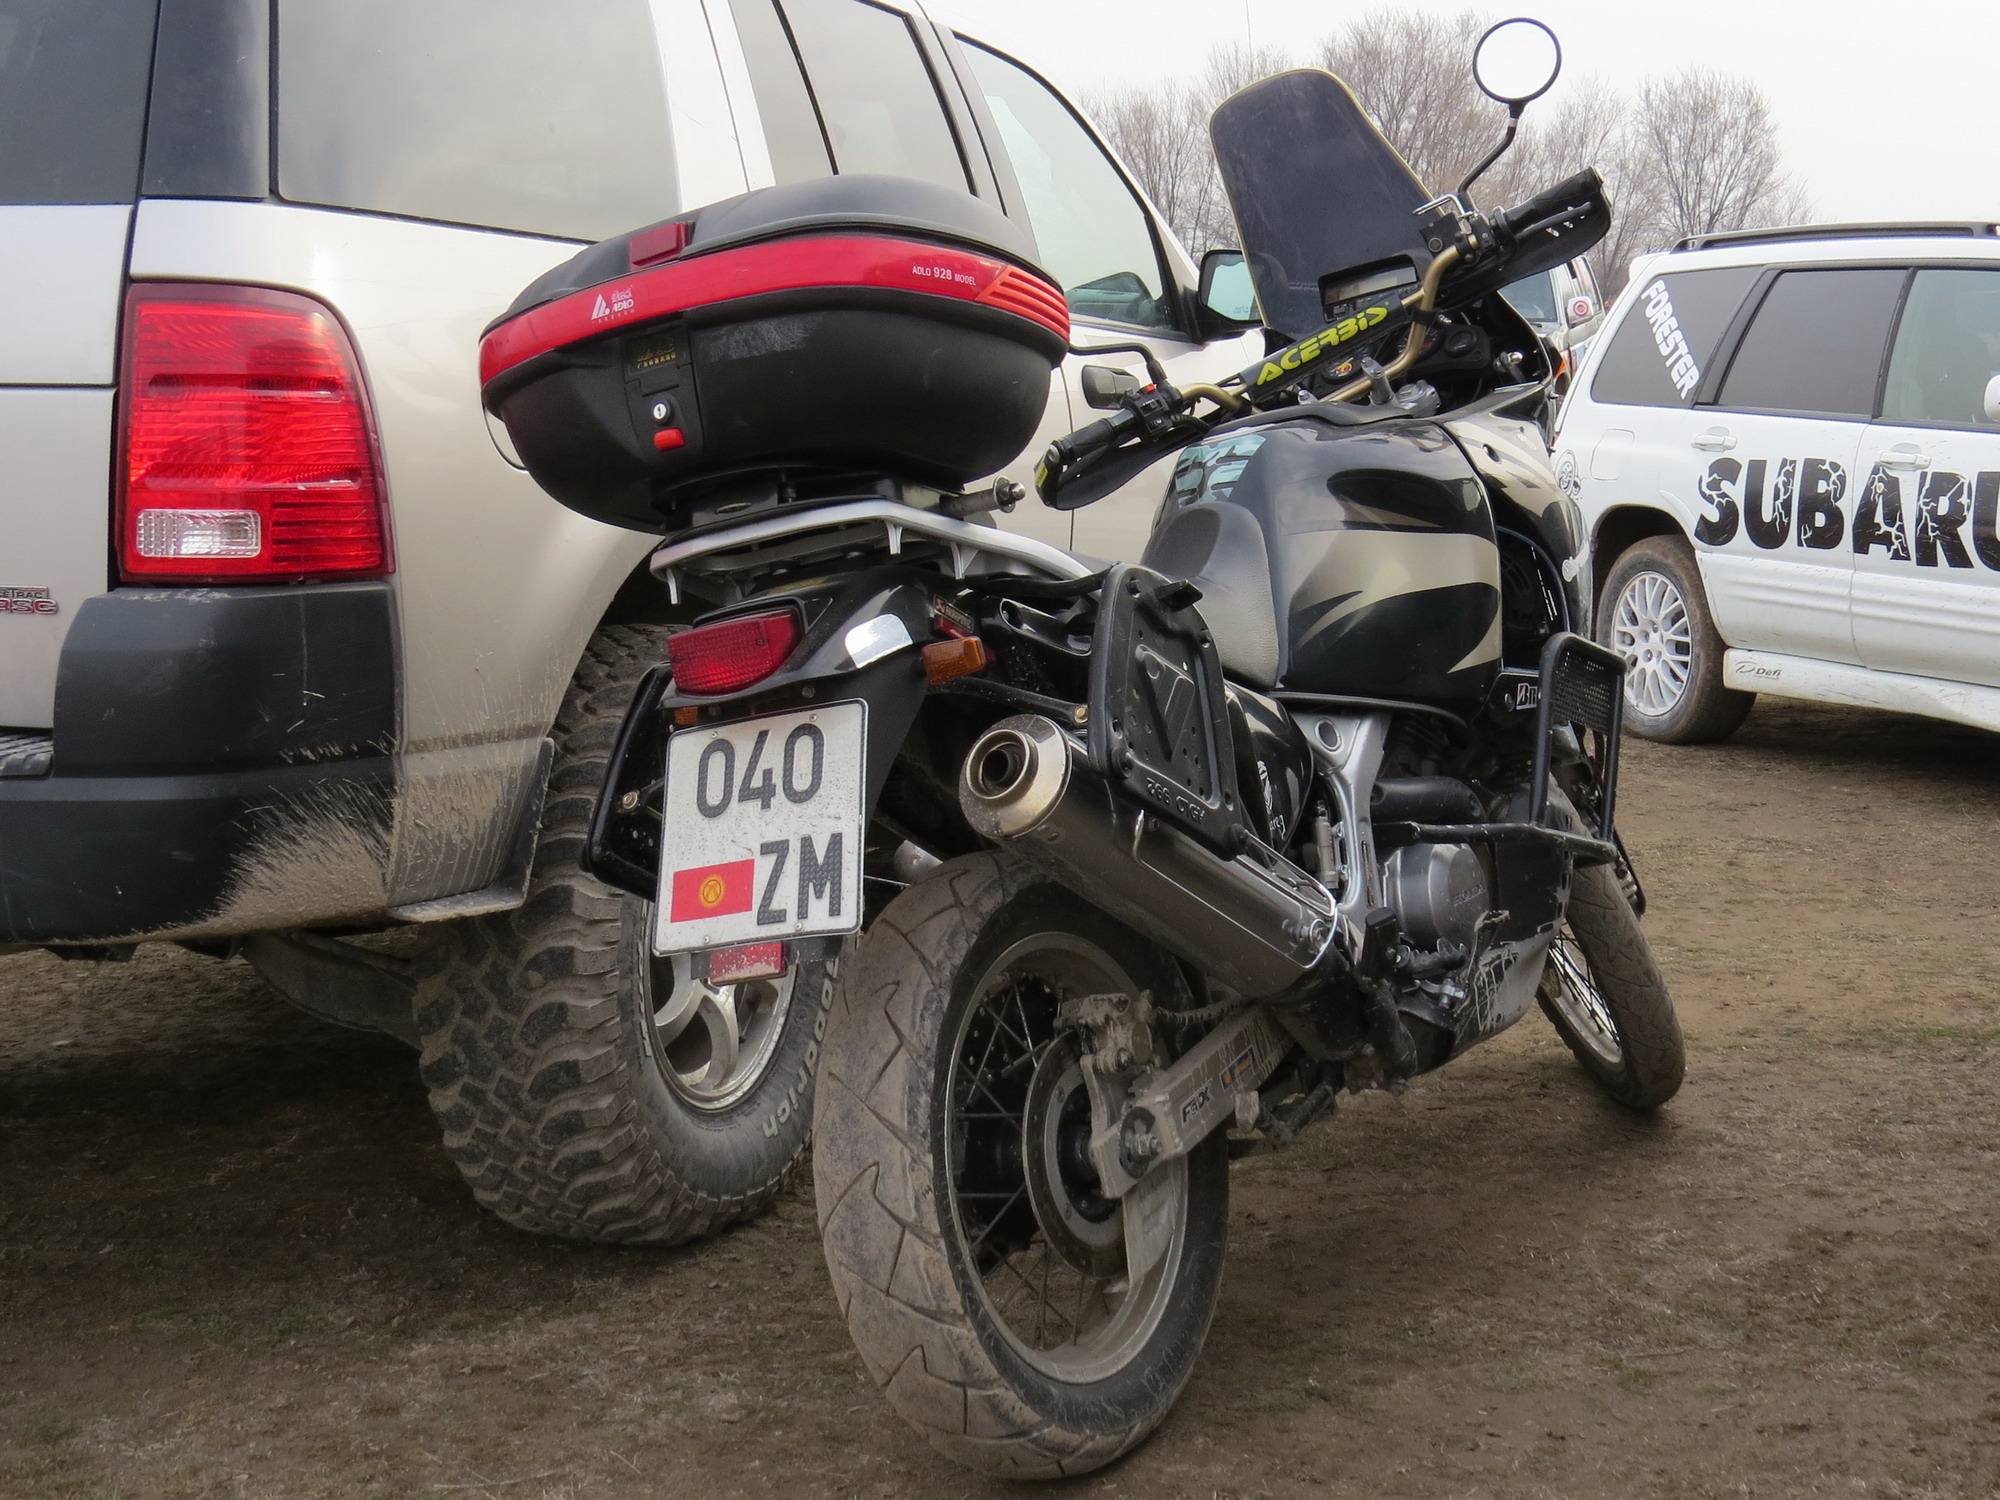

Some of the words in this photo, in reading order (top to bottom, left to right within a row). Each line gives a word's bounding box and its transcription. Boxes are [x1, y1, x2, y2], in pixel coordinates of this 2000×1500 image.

[912, 265, 931, 277] ADLO
[933, 266, 953, 281] 928
[954, 273, 977, 286] MODEL
[1640, 279, 1701, 400] FORESTER
[1694, 456, 2000, 573] SUBARU
[696, 723, 825, 818] 040
[756, 832, 843, 926] ZM
